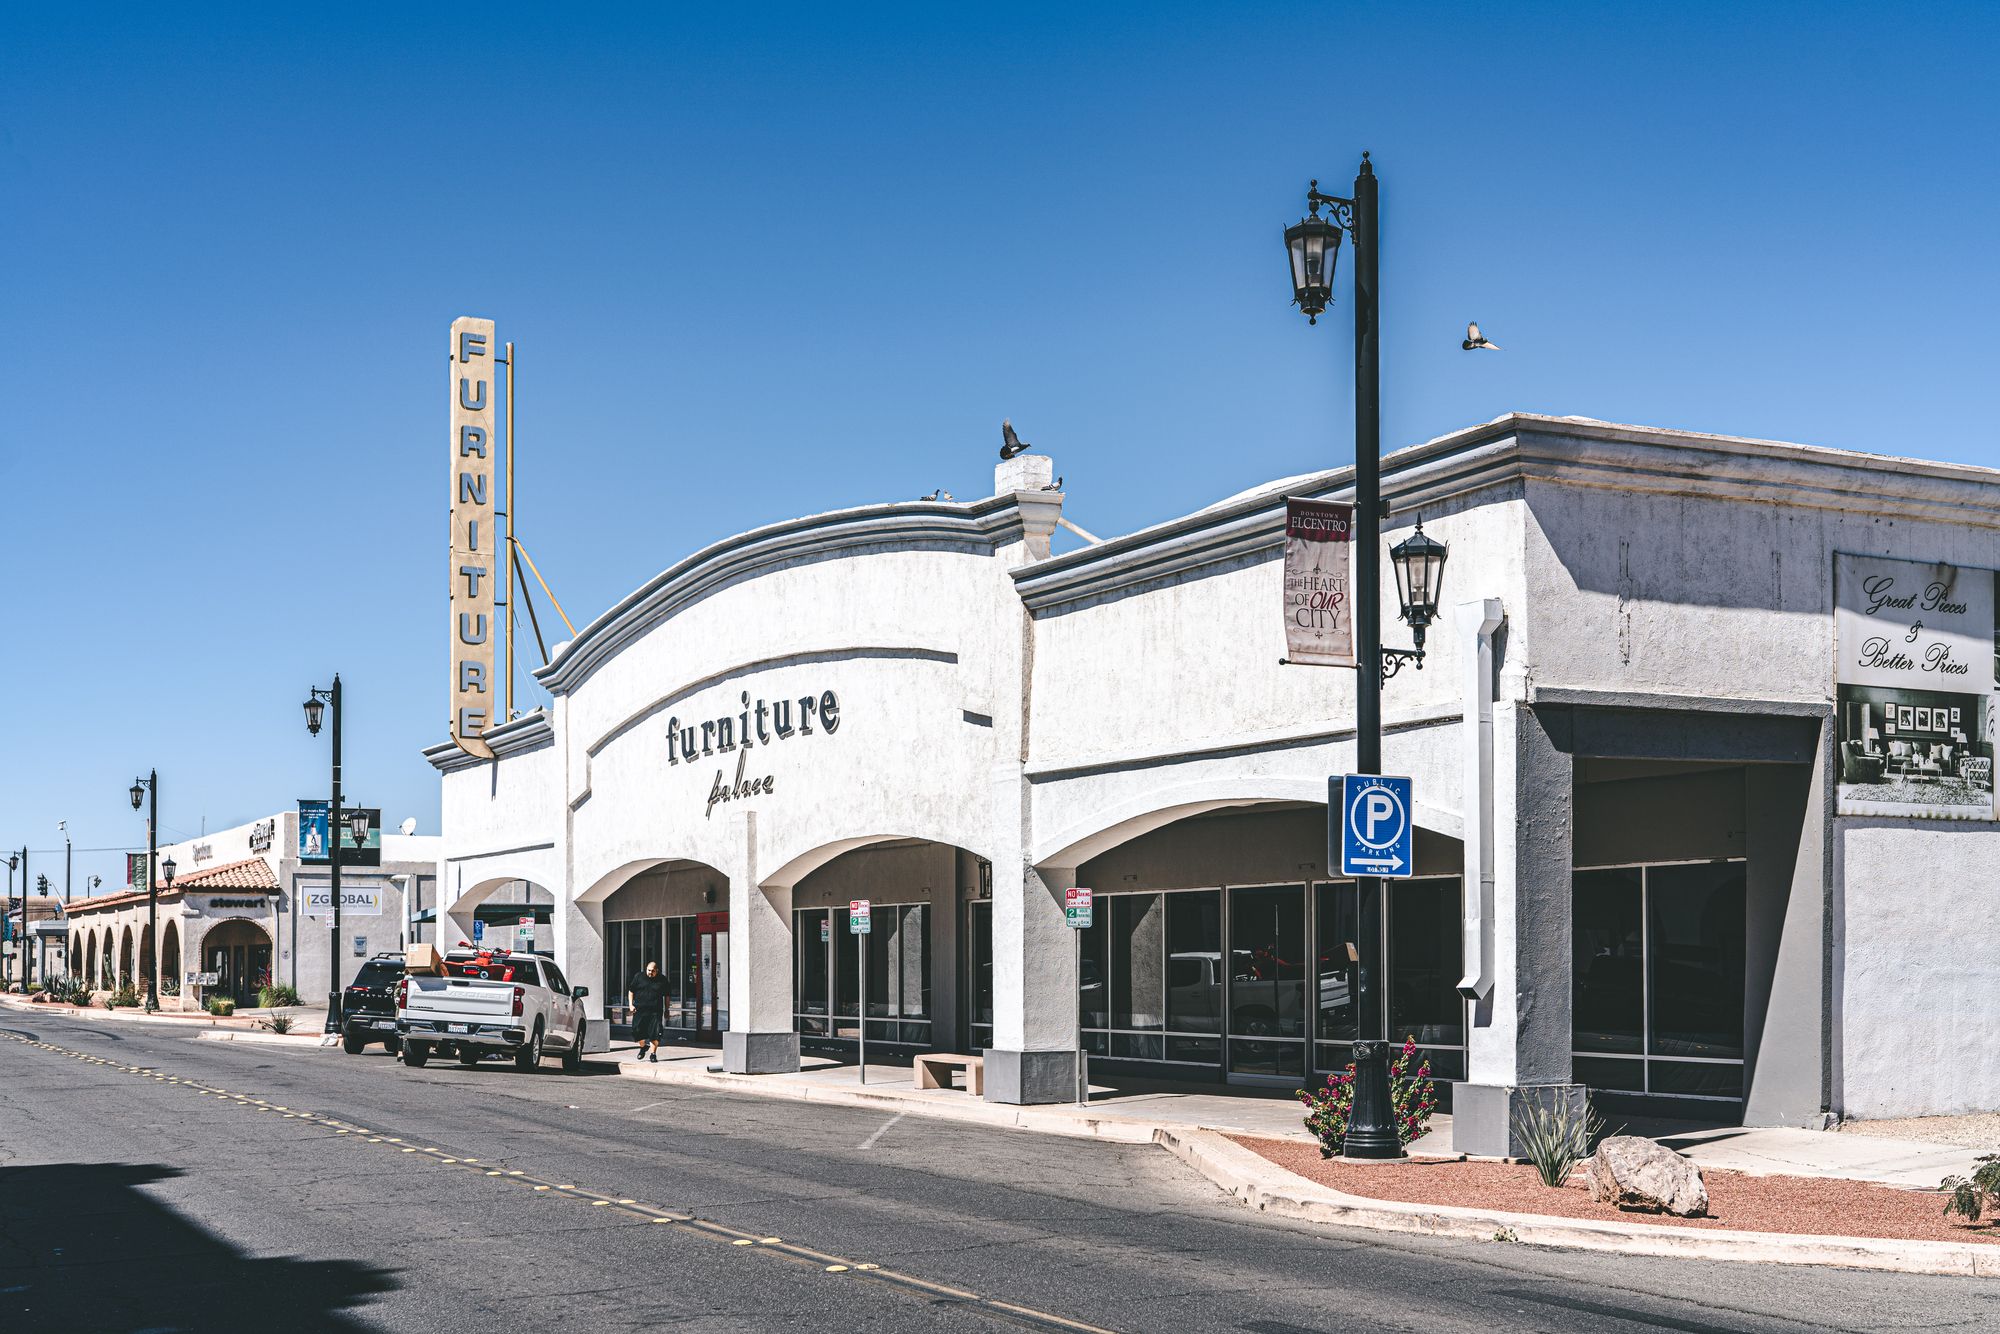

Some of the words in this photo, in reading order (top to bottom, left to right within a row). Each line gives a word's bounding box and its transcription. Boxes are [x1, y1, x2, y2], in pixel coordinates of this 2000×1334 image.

[1300, 510, 1339, 519] DOWNTOWN
[460, 332, 487, 738] FURNITURE
[1290, 578, 1303, 588] THE
[1304, 576, 1344, 592] HEART
[1295, 594, 1310, 606] OF
[1310, 591, 1344, 610] OUR
[1863, 576, 1917, 615] Great
[1920, 582, 1968, 614] Pieces
[1296, 608, 1341, 630] CITY
[1905, 620, 1924, 643] &
[1858, 636, 1914, 670] Better
[1922, 642, 1968, 674] Prices
[666, 690, 840, 766] furniture
[705, 747, 774, 820] palace
[1356, 778, 1400, 794] PUBLIC
[1366, 794, 1394, 840] P
[1356, 841, 1400, 856] PARKING
[210, 898, 265, 908] stewart
[311, 894, 372, 904] ZGOBAL
[1068, 909, 1075, 917] 2
